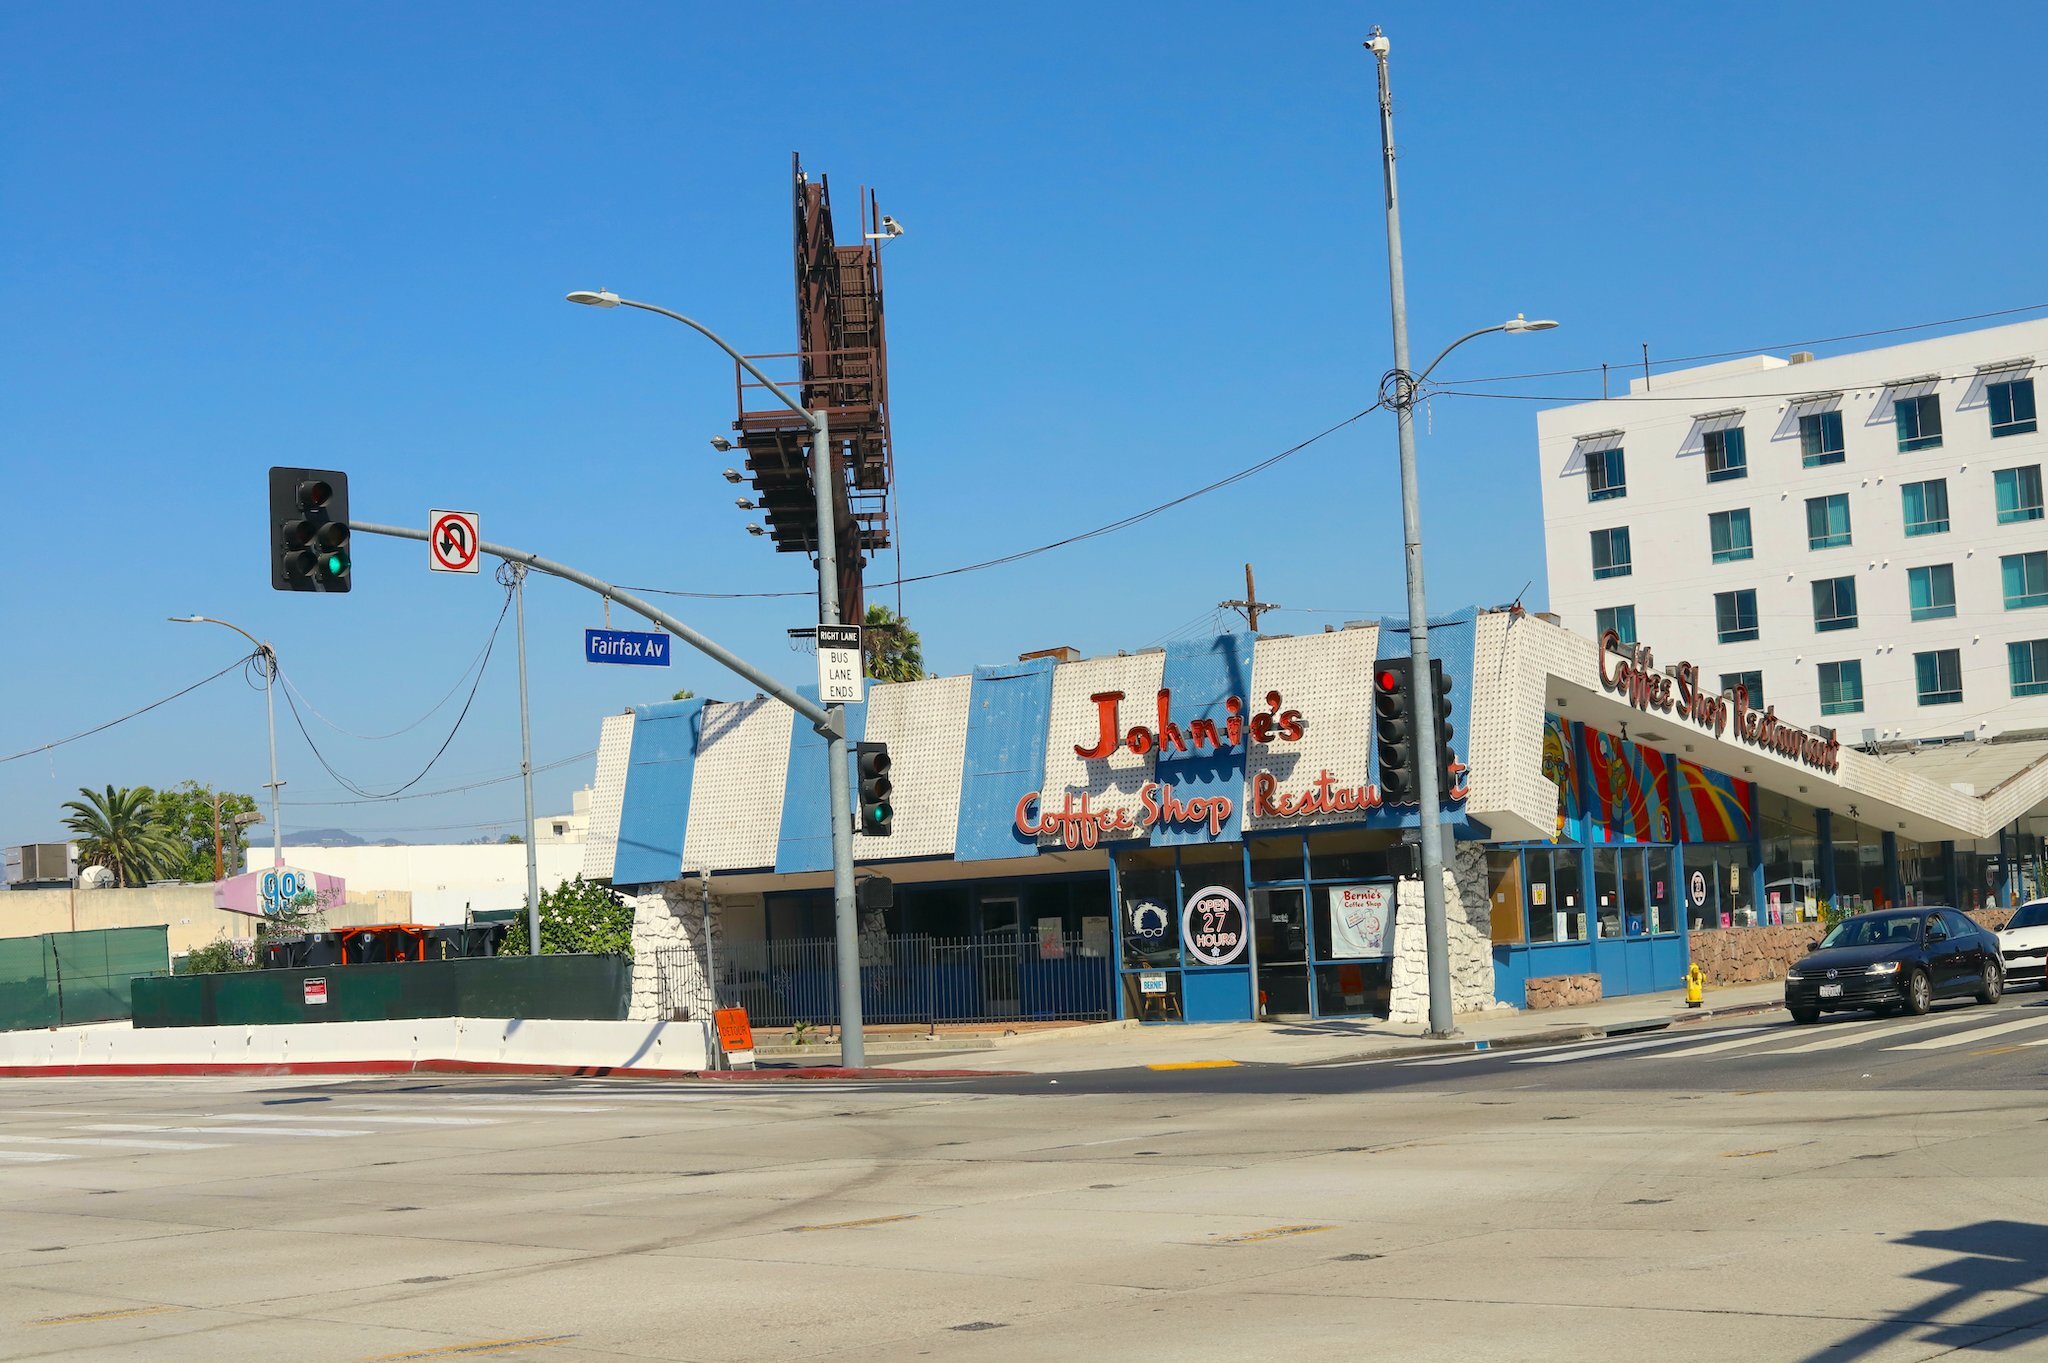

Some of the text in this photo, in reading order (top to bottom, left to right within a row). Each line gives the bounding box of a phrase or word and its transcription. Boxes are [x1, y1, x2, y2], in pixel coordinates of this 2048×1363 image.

[820, 631, 858, 641] RIGHT LANE
[591, 636, 663, 657] Fairfax Av
[830, 651, 849, 663] BUS
[829, 669, 852, 680] LANE
[830, 686, 854, 698] ENDS
[1599, 628, 1840, 772] Coffee Shop Restaurant
[1074, 688, 1305, 759] Johnie's
[1015, 755, 1469, 850] Coffee Shop Restaut
[1343, 889, 1381, 901] Bernie's
[1196, 898, 1230, 913] OPEN
[1366, 901, 1381, 909] Shop
[1202, 912, 1226, 933] 27
[1196, 932, 1238, 947] HOURS
[722, 1025, 746, 1037] DETOUR
